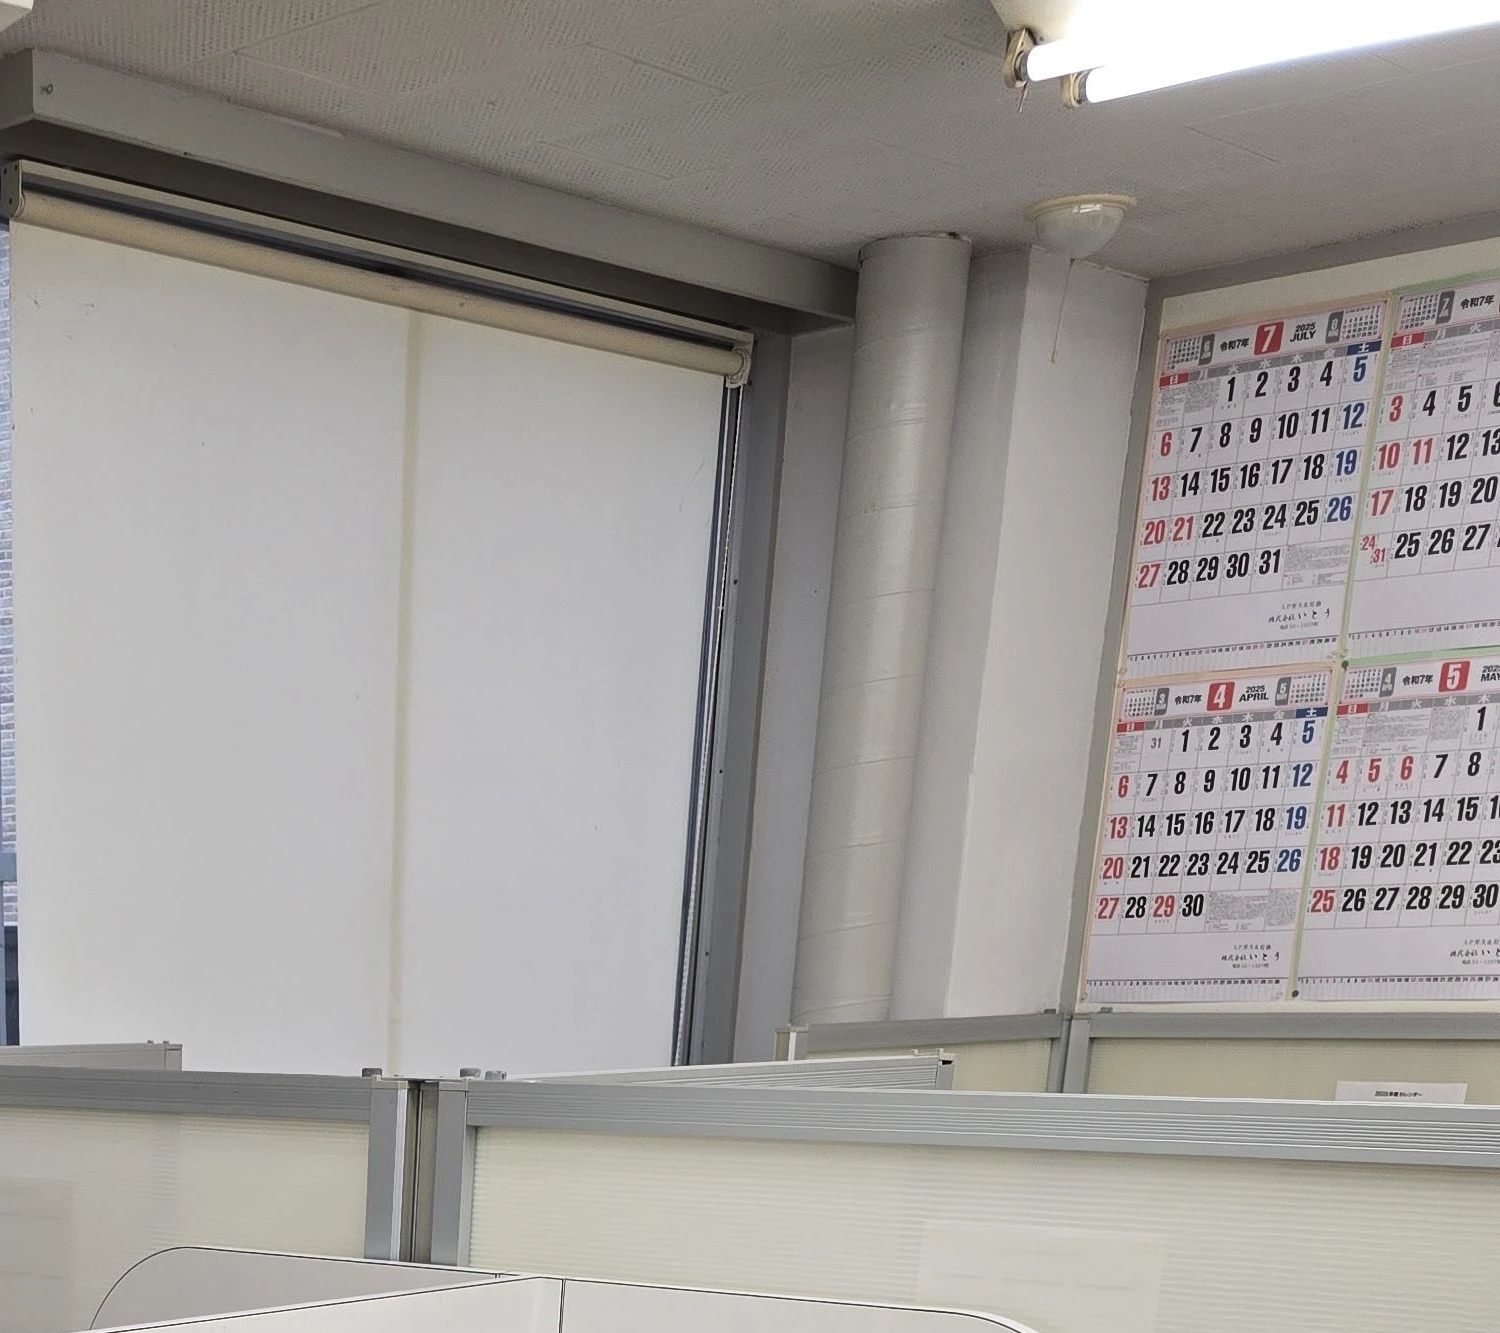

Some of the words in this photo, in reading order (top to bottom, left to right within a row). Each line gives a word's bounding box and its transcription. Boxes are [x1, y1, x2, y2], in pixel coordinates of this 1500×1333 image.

[1461, 295, 1494, 309] 令和7年
[1261, 325, 1277, 352] 7
[1290, 330, 1316, 342] JULY
[1295, 323, 1315, 332] 2025
[1403, 336, 1412, 345] 日
[1436, 328, 1446, 339] 月
[1470, 323, 1482, 333] 火
[1220, 338, 1249, 351] 令和7年
[1170, 376, 1178, 384] 日
[1228, 365, 1238, 374] 火
[1260, 359, 1270, 369] 水
[1292, 353, 1303, 364] 木
[1358, 343, 1369, 352] 土
[1228, 377, 1236, 402] 1
[1255, 372, 1269, 397] 2
[1287, 366, 1300, 392] 3
[1320, 361, 1333, 386] 4
[1353, 356, 1368, 382] 5
[1389, 396, 1403, 422] 3
[1423, 391, 1436, 416] 4
[1458, 385, 1473, 412] 5
[1161, 432, 1172, 456] 6
[1190, 427, 1202, 452] 7
[1220, 423, 1231, 447] 8
[1250, 418, 1262, 443] 9
[1278, 413, 1299, 439] 10
[1311, 408, 1330, 434] 11
[1343, 403, 1365, 429] 12
[1379, 443, 1400, 470] 10
[1413, 437, 1433, 465] 11
[1447, 433, 1469, 461] 12
[1152, 476, 1171, 501] 13
[1181, 472, 1199, 497] 14
[1211, 467, 1231, 493] 15
[1240, 463, 1260, 488] 16
[1272, 458, 1293, 484] 17
[1304, 454, 1324, 480] 18
[1336, 450, 1357, 476] 19
[1372, 490, 1394, 516] 17
[1405, 485, 1428, 512] 18
[1440, 481, 1462, 508] 19
[1470, 476, 1498, 504] 20
[1143, 520, 1165, 545] 20
[1172, 516, 1194, 541] 21
[1202, 512, 1225, 538] 22
[1232, 508, 1255, 534] 23
[1263, 504, 1286, 530] 24
[1294, 500, 1319, 526] 25
[1327, 496, 1352, 522] 26
[1362, 536, 1375, 550] 24
[1395, 532, 1421, 559] 25
[1428, 528, 1455, 555] 26
[1462, 524, 1491, 551] 27
[1373, 548, 1385, 563] 31
[1138, 563, 1160, 588] 27
[1166, 560, 1189, 585] 28
[1196, 557, 1219, 582] 29
[1227, 553, 1249, 578] 30
[1259, 549, 1281, 574] 31
[1246, 685, 1265, 693] 2025
[1384, 671, 1392, 684] 4
[1402, 675, 1433, 685] 令和7年
[1447, 664, 1462, 690] 5
[1175, 695, 1202, 705] 令和7年
[1214, 684, 1226, 708] 4
[1239, 692, 1268, 702] APRIL
[1348, 705, 1356, 713] 日
[1380, 703, 1389, 712] 月
[1412, 699, 1422, 709] 火
[1444, 696, 1457, 705] 水
[1477, 693, 1491, 704] 木
[1127, 723, 1134, 731] 日
[1183, 718, 1192, 727] 火
[1212, 715, 1223, 724] 水
[1242, 712, 1253, 722] 木
[1306, 708, 1317, 717] 土
[1477, 706, 1486, 731] 1
[1151, 737, 1162, 749] 31
[1182, 730, 1189, 752] 1
[1208, 727, 1220, 750] 2
[1240, 725, 1251, 748] 3
[1271, 723, 1282, 745] 4
[1302, 720, 1315, 743] 5
[1118, 775, 1129, 798] 6
[1146, 773, 1157, 796] 7
[1174, 771, 1186, 794] 8
[1204, 770, 1215, 792] 9
[1231, 767, 1250, 791] 10
[1262, 765, 1280, 789] 11
[1293, 763, 1313, 787] 12
[1336, 760, 1349, 784] 4
[1368, 758, 1382, 782] 5
[1401, 756, 1413, 780] 6
[1434, 754, 1448, 778] 7
[1468, 752, 1481, 776] 8
[1110, 816, 1128, 839] 13
[1138, 815, 1156, 837] 14
[1166, 813, 1185, 836] 15
[1195, 812, 1214, 834] 16
[1225, 810, 1245, 833] 17
[1255, 808, 1275, 831] 18
[1286, 806, 1307, 829] 19
[1327, 804, 1345, 827] 11
[1358, 802, 1379, 826] 12
[1390, 800, 1412, 825] 13
[1424, 798, 1445, 823] 14
[1457, 797, 1479, 821] 15
[1490, 795, 1500, 819] 1
[1103, 857, 1124, 879] 20
[1131, 856, 1150, 878] 21
[1158, 854, 1180, 877] 22
[1187, 853, 1209, 876] 23
[1217, 852, 1239, 874] 24
[1246, 850, 1270, 873] 25
[1277, 849, 1301, 872] 26
[1320, 847, 1341, 870] 18
[1351, 845, 1372, 869] 19
[1380, 844, 1406, 868] 20
[1414, 842, 1437, 867] 21
[1446, 841, 1472, 865] 22
[1098, 897, 1119, 919] 27
[1125, 896, 1147, 918] 28
[1153, 895, 1175, 917] 29
[1182, 894, 1204, 917] 30
[1311, 890, 1335, 913] 25
[1342, 888, 1366, 912] 26
[1374, 887, 1399, 911] 27
[1406, 886, 1432, 910] 28
[1439, 885, 1464, 909] 29
[1472, 883, 1499, 908] 30
